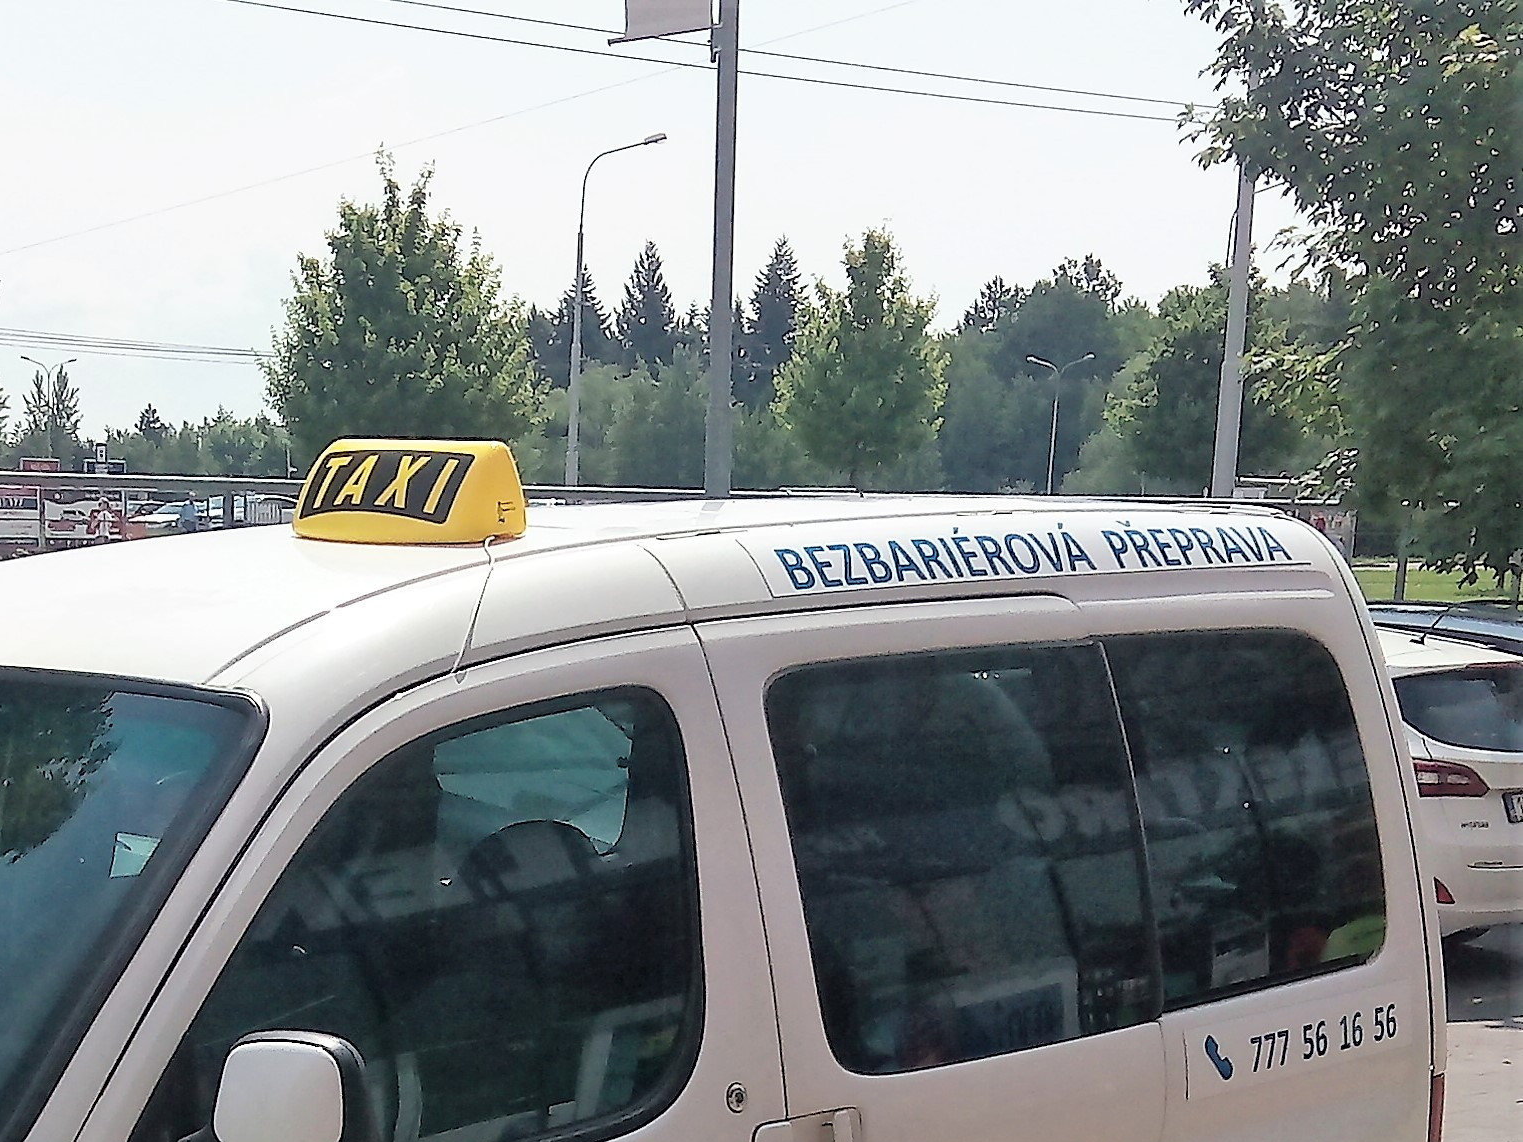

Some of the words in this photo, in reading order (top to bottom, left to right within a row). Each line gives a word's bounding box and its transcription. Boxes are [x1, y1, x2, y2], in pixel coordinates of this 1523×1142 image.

[312, 453, 461, 515] TAXI
[773, 522, 1097, 592] BEZBARIÉROVÁ
[1100, 519, 1294, 569] PŘEPRAVA
[1250, 1029, 1289, 1073] 777
[1303, 1020, 1328, 1060] 56
[1340, 1011, 1363, 1050] 16
[1374, 1003, 1397, 1042] 56
